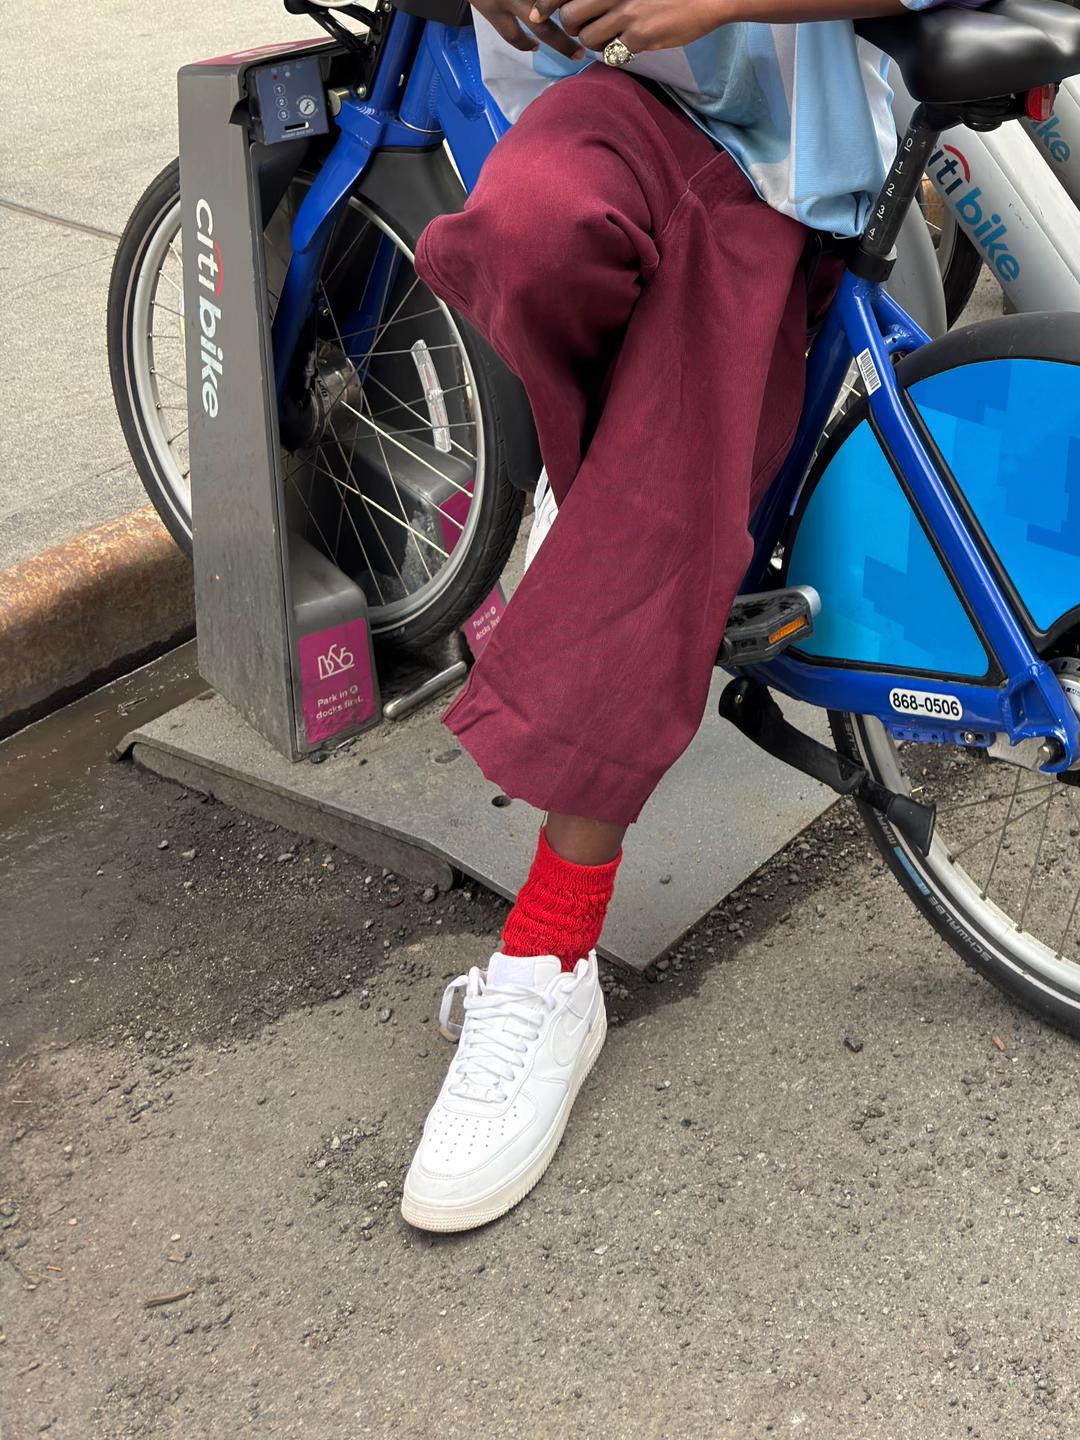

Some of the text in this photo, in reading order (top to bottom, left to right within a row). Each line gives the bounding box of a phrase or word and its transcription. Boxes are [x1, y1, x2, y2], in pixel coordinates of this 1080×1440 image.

[927, 146, 1020, 282] iti bike
[196, 198, 224, 419] citi bike
[316, 704, 343, 720] docks
[317, 689, 348, 708] Park in
[892, 691, 961, 717] 868-0506
[927, 895, 993, 961] SCHWALBE
